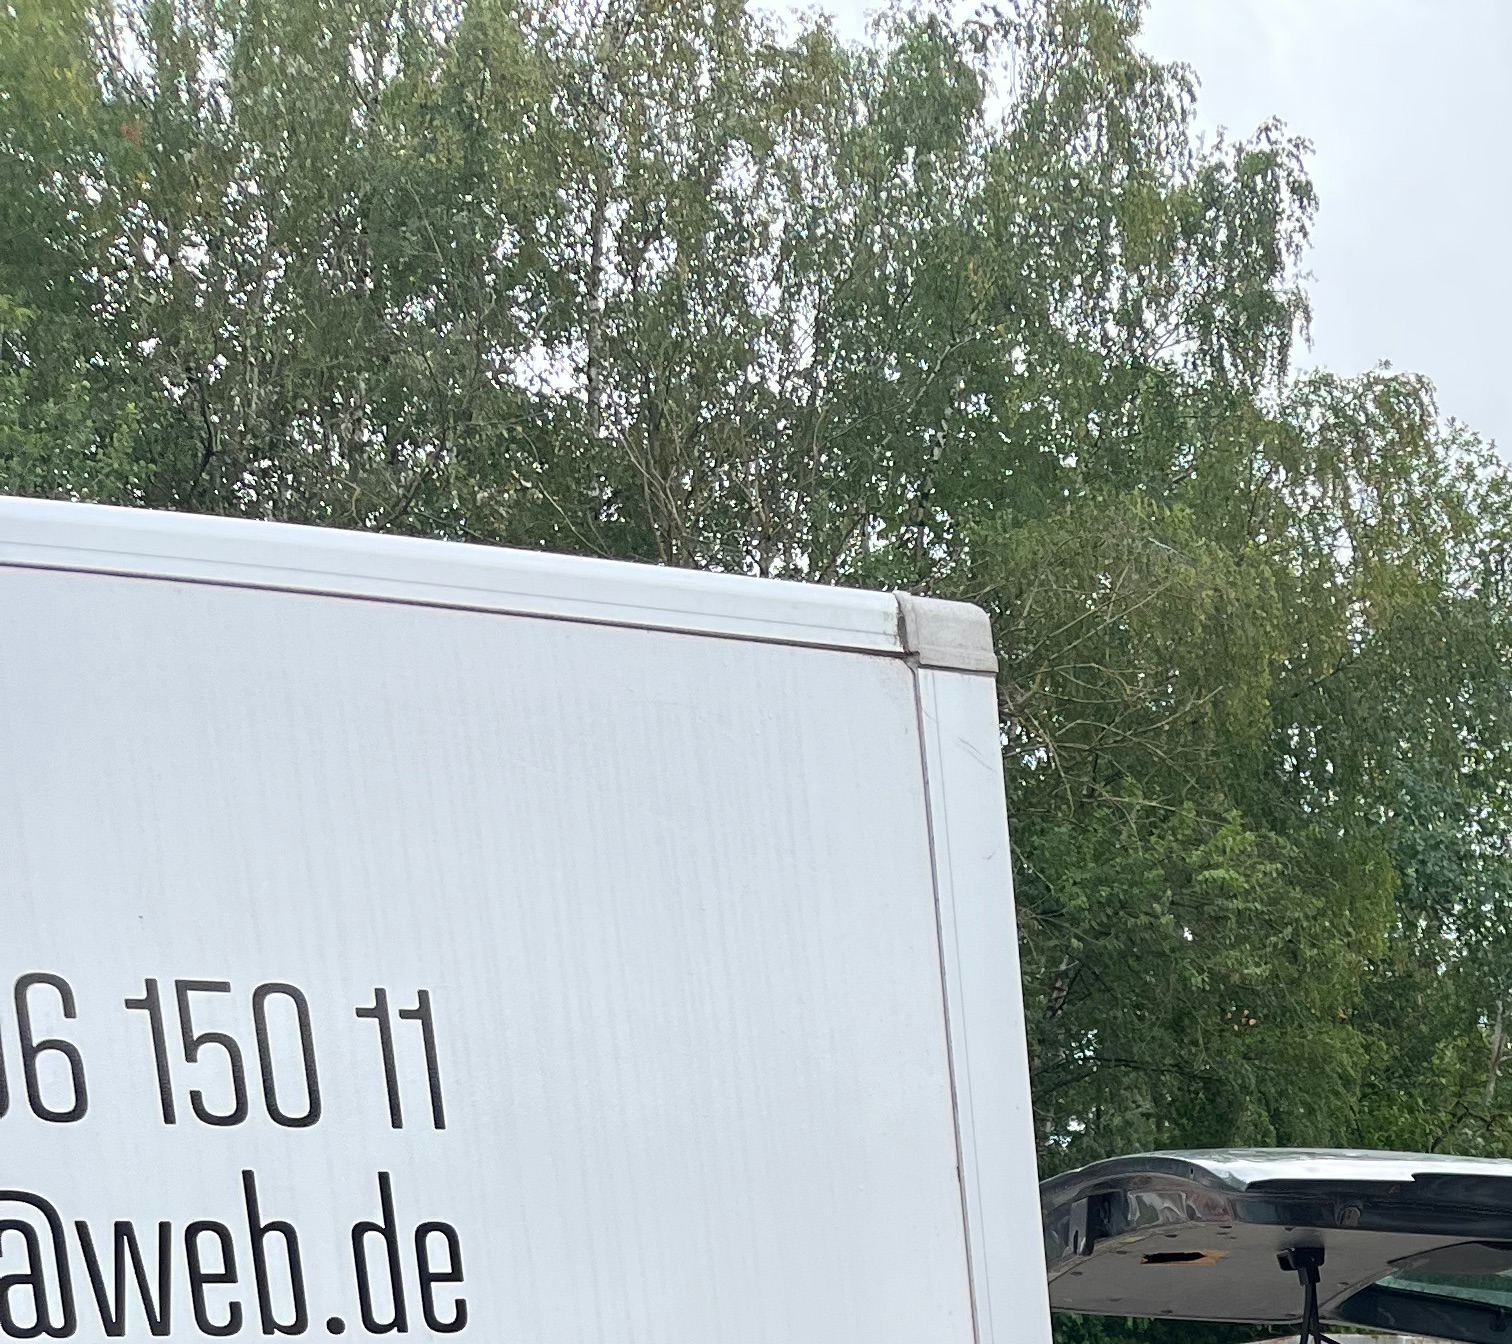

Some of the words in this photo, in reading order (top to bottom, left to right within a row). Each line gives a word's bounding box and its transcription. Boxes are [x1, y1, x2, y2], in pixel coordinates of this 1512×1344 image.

[0, 971, 89, 1123] 6
[124, 977, 322, 1128] 150
[355, 986, 447, 1130] 11
